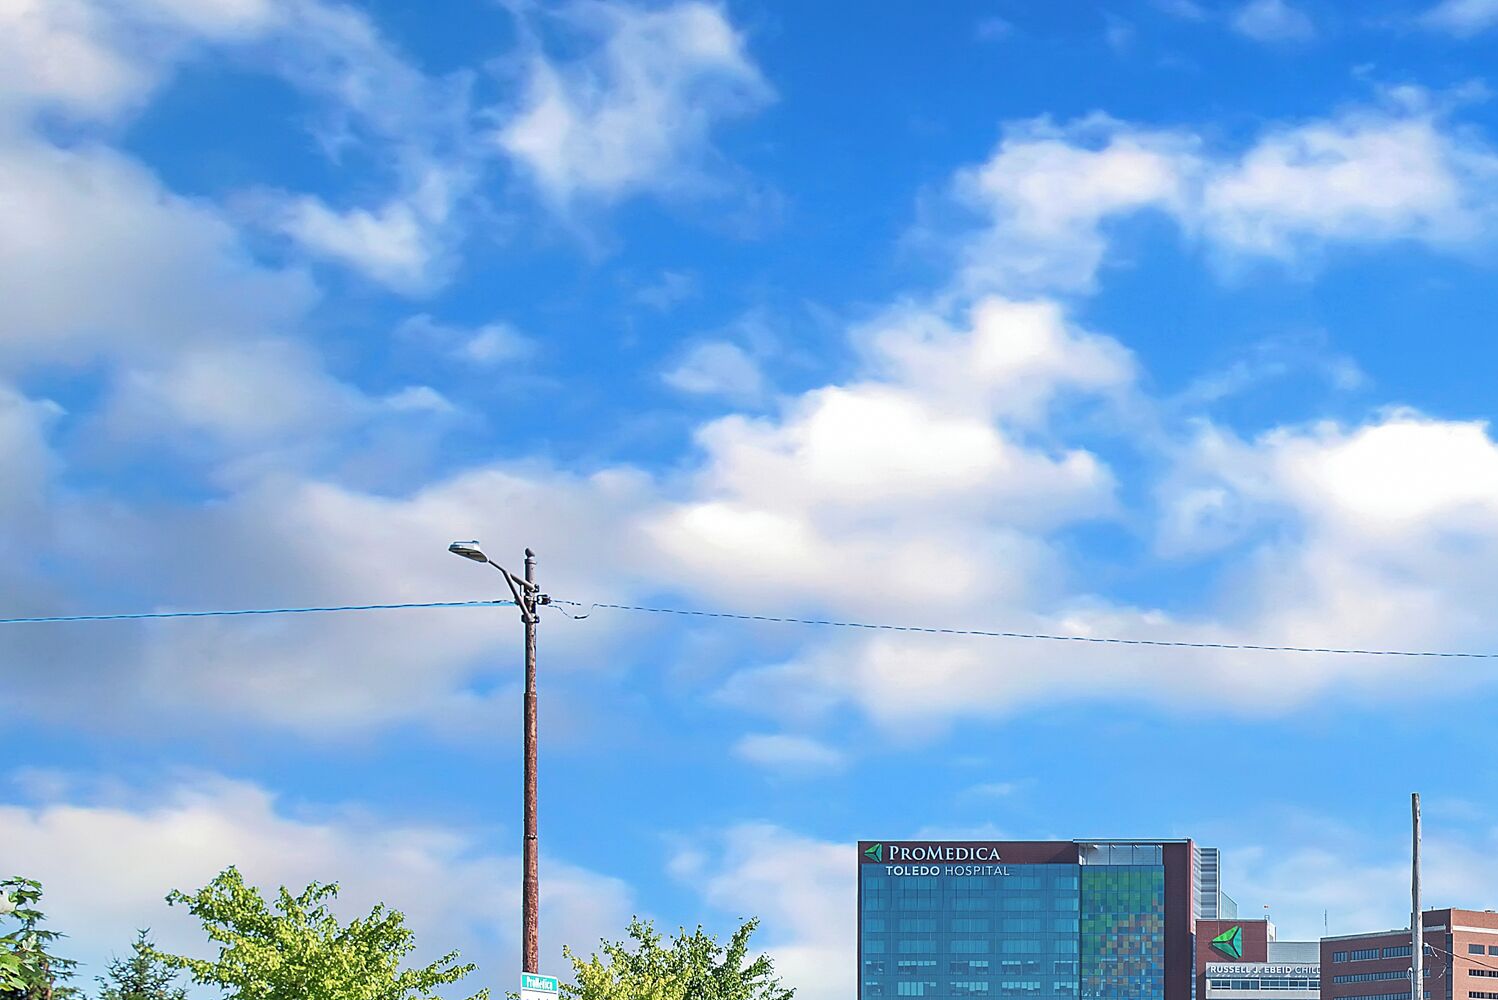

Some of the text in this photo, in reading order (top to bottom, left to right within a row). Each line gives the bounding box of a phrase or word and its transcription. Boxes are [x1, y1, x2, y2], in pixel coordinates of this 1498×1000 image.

[886, 865, 1010, 876] TOLEDO HOSPITAL
[1210, 965, 1251, 974] RUSSELL
[1264, 965, 1292, 974] EBEID
